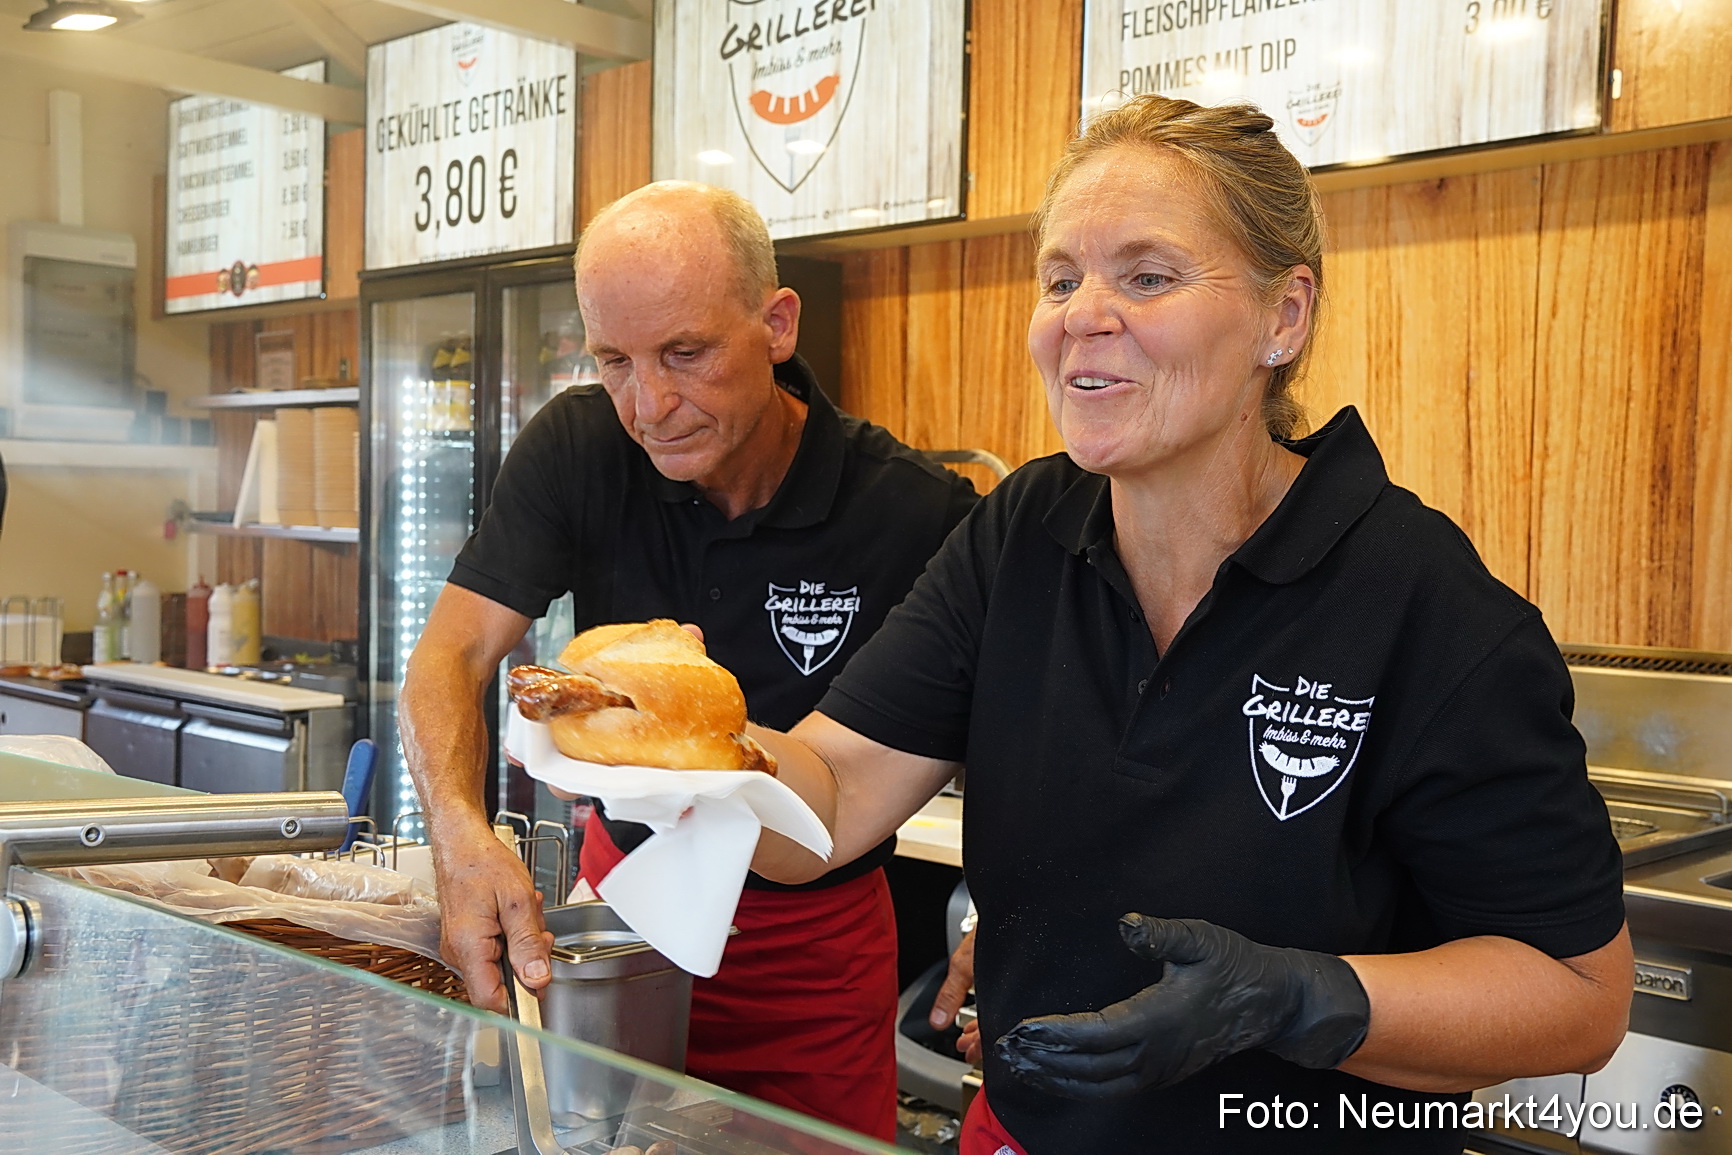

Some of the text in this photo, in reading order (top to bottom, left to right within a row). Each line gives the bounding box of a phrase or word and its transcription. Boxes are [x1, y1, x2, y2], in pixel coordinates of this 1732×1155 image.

[1121, 0, 1315, 41] FLEISCHPFLA
[1120, 55, 1207, 97] POMMES
[1261, 38, 1296, 73] DIP
[377, 75, 567, 153] GEKÜHLTE GETRÄNKE
[415, 148, 518, 239] 3,80 €
[765, 595, 860, 612] GRILLEREI
[799, 580, 825, 595] DIE
[1295, 675, 1332, 699] DIE
[1242, 694, 1371, 732] GRILLERE
[1263, 724, 1347, 749] Imbiss & mehr
